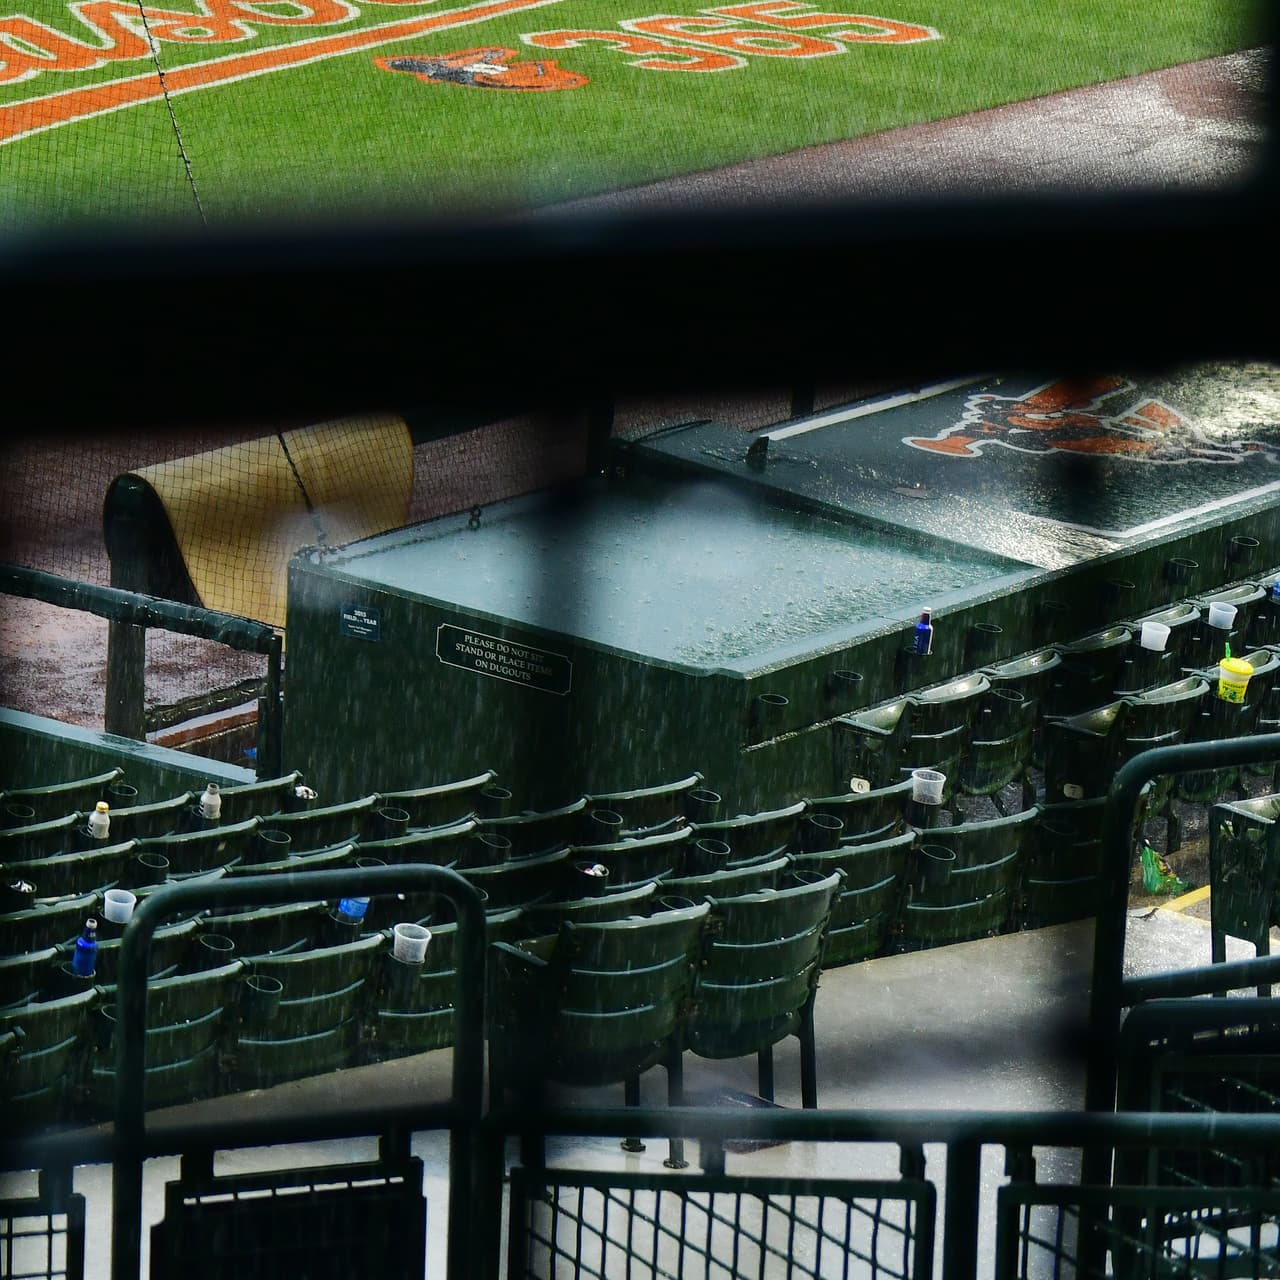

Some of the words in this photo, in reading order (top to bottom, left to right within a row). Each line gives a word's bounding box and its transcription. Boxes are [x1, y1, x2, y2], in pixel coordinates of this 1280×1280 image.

[520, 0, 941, 72] 365
[455, 643, 484, 657] STAND
[484, 651, 497, 661] OR
[498, 655, 525, 669] PLACE
[464, 634, 495, 650] PLEASE
[496, 644, 510, 653] DO
[510, 648, 529, 658] NOT
[474, 659, 489, 669] ON
[489, 663, 532, 681] DUGOUTS
